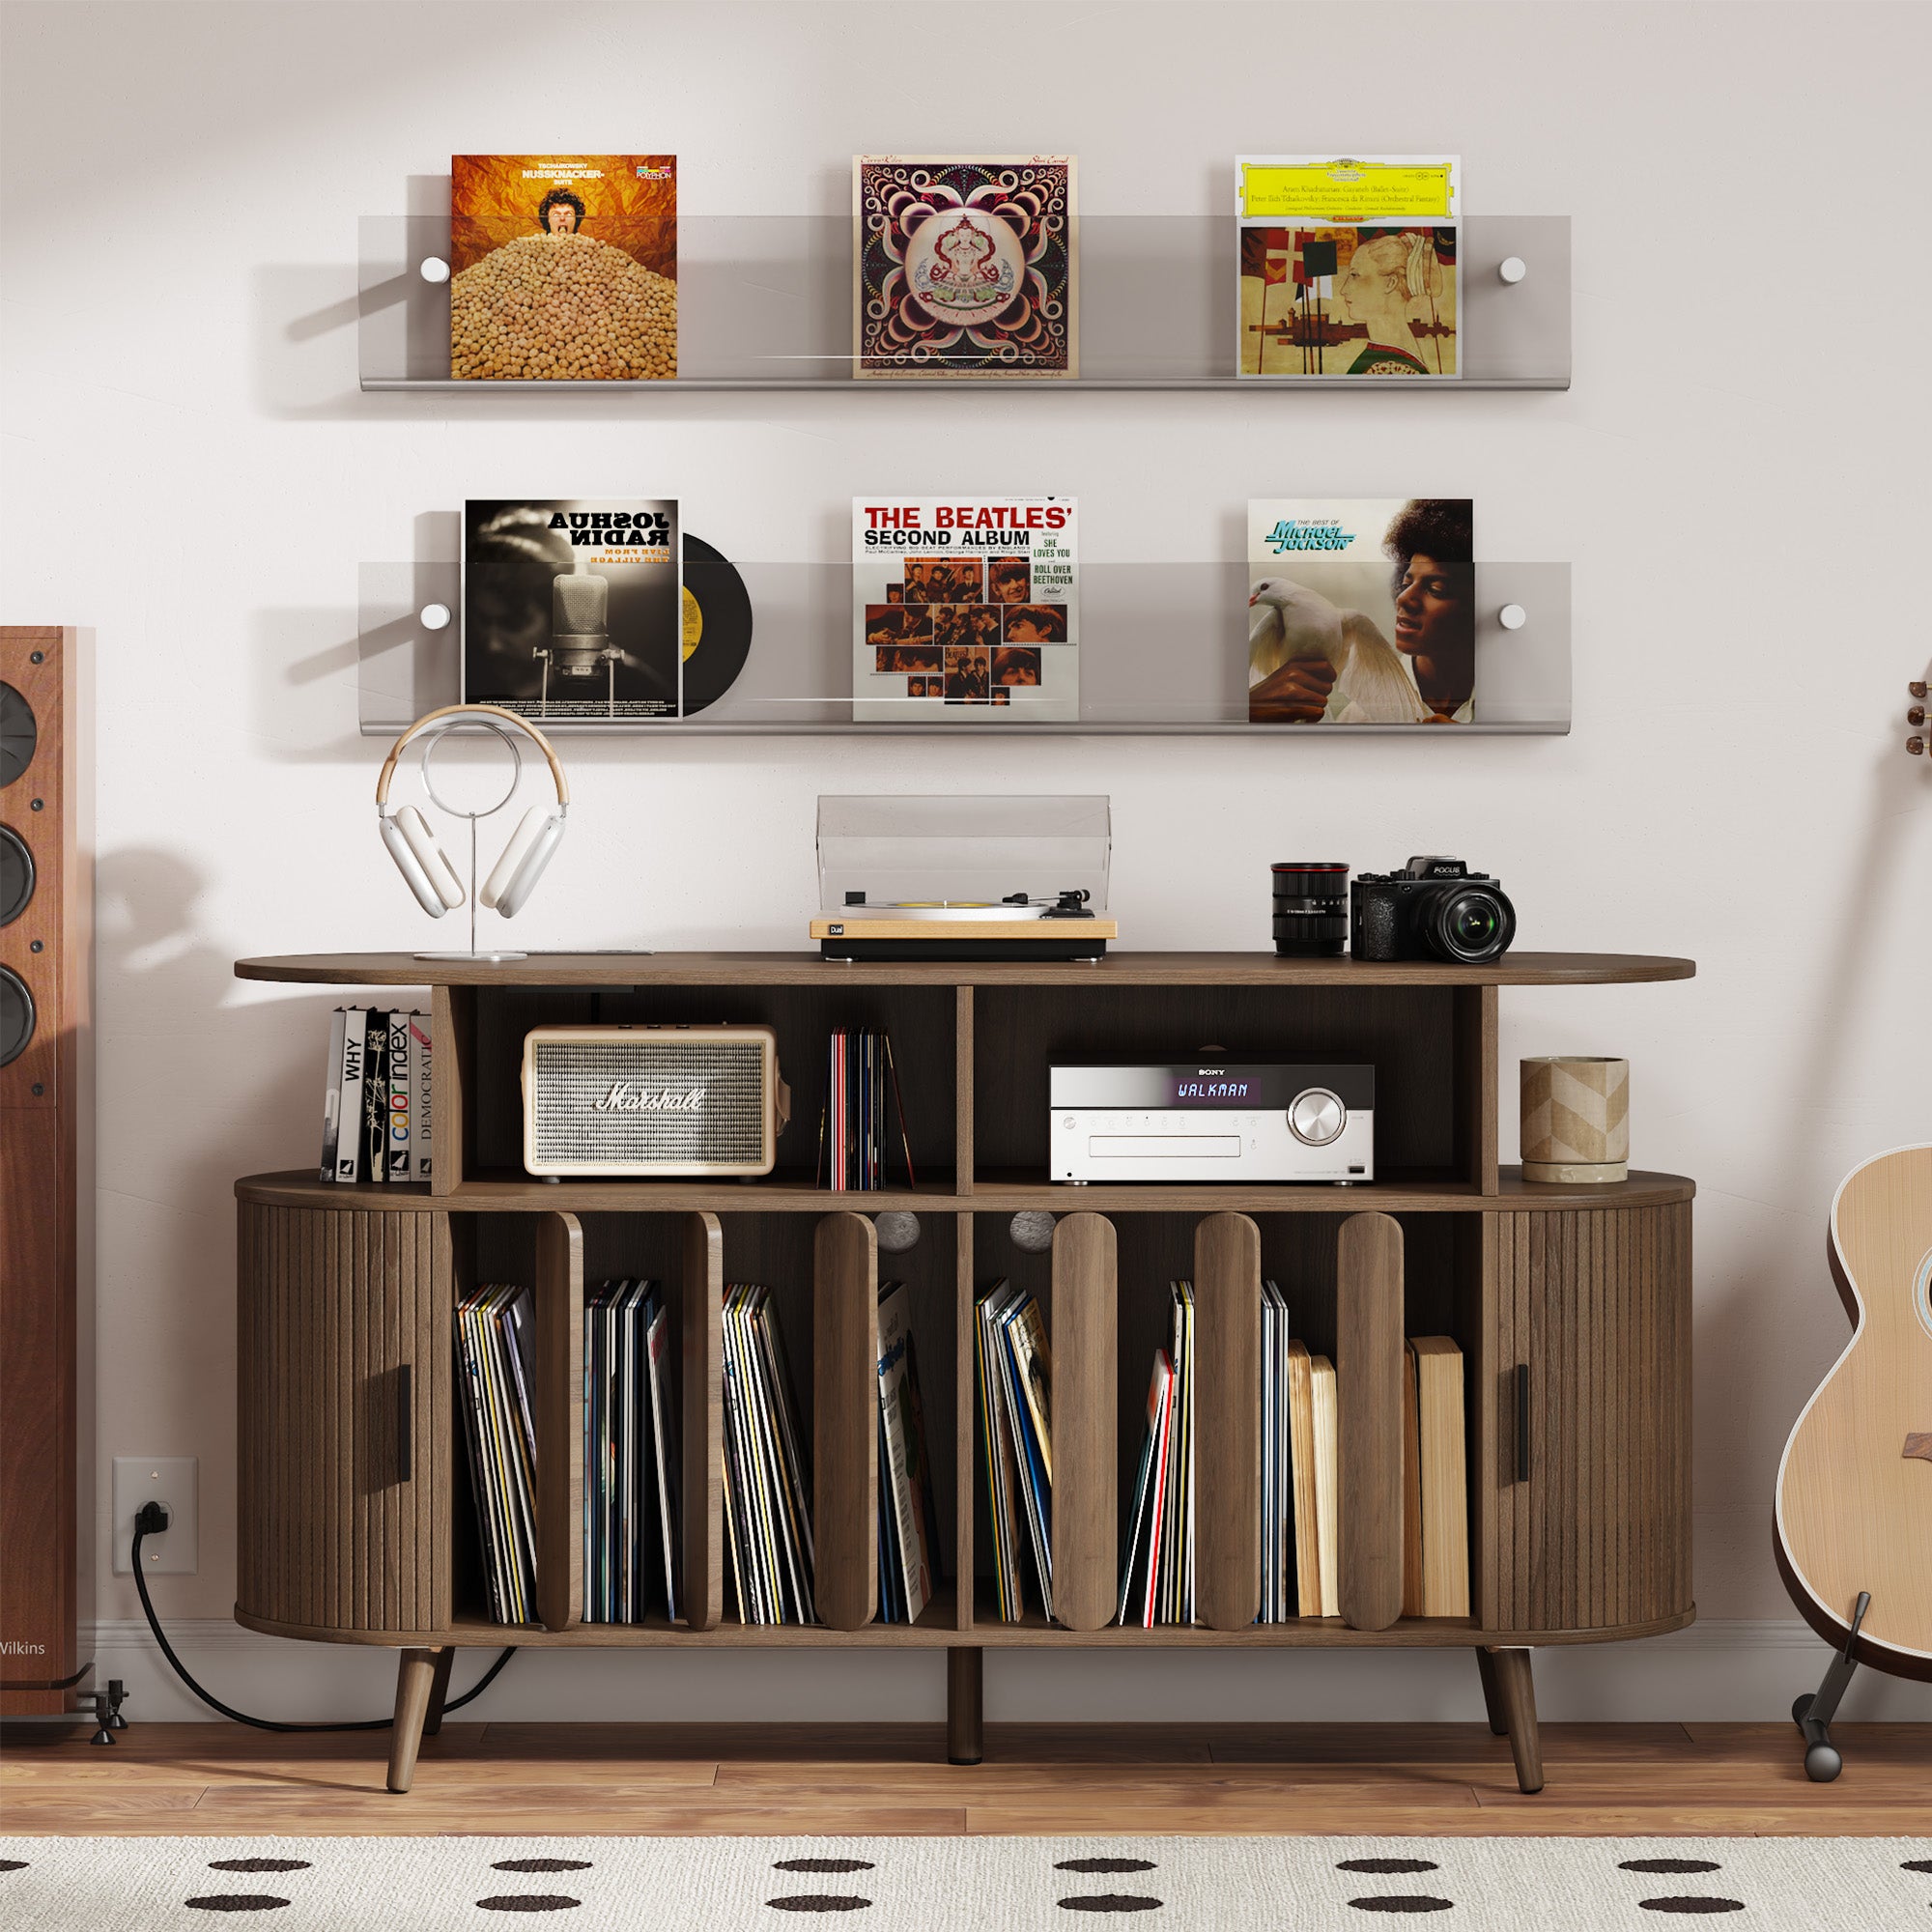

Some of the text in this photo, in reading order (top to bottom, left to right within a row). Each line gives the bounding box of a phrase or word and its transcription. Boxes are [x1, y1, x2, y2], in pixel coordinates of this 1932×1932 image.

[522, 169, 605, 179] NUSSKNACKER-
[636, 171, 671, 180] POLYPHON
[865, 507, 1072, 528] THE BEATLES'
[865, 529, 1030, 546] SECOND ALBUM
[1043, 539, 1057, 548] SHE
[1033, 549, 1070, 557] LOVES YOU
[1035, 565, 1071, 574] ROLL OVER
[1033, 576, 1073, 584] BEETHOVEN
[1434, 866, 1461, 874] FOCUS
[831, 925, 843, 934] Dual
[345, 1038, 361, 1082] WHY
[389, 1023, 410, 1141] color index
[421, 1035, 432, 1140] DEMOCRATIC
[1178, 1083, 1248, 1097] WALKMAN
[596, 1081, 707, 1110] Marshall
